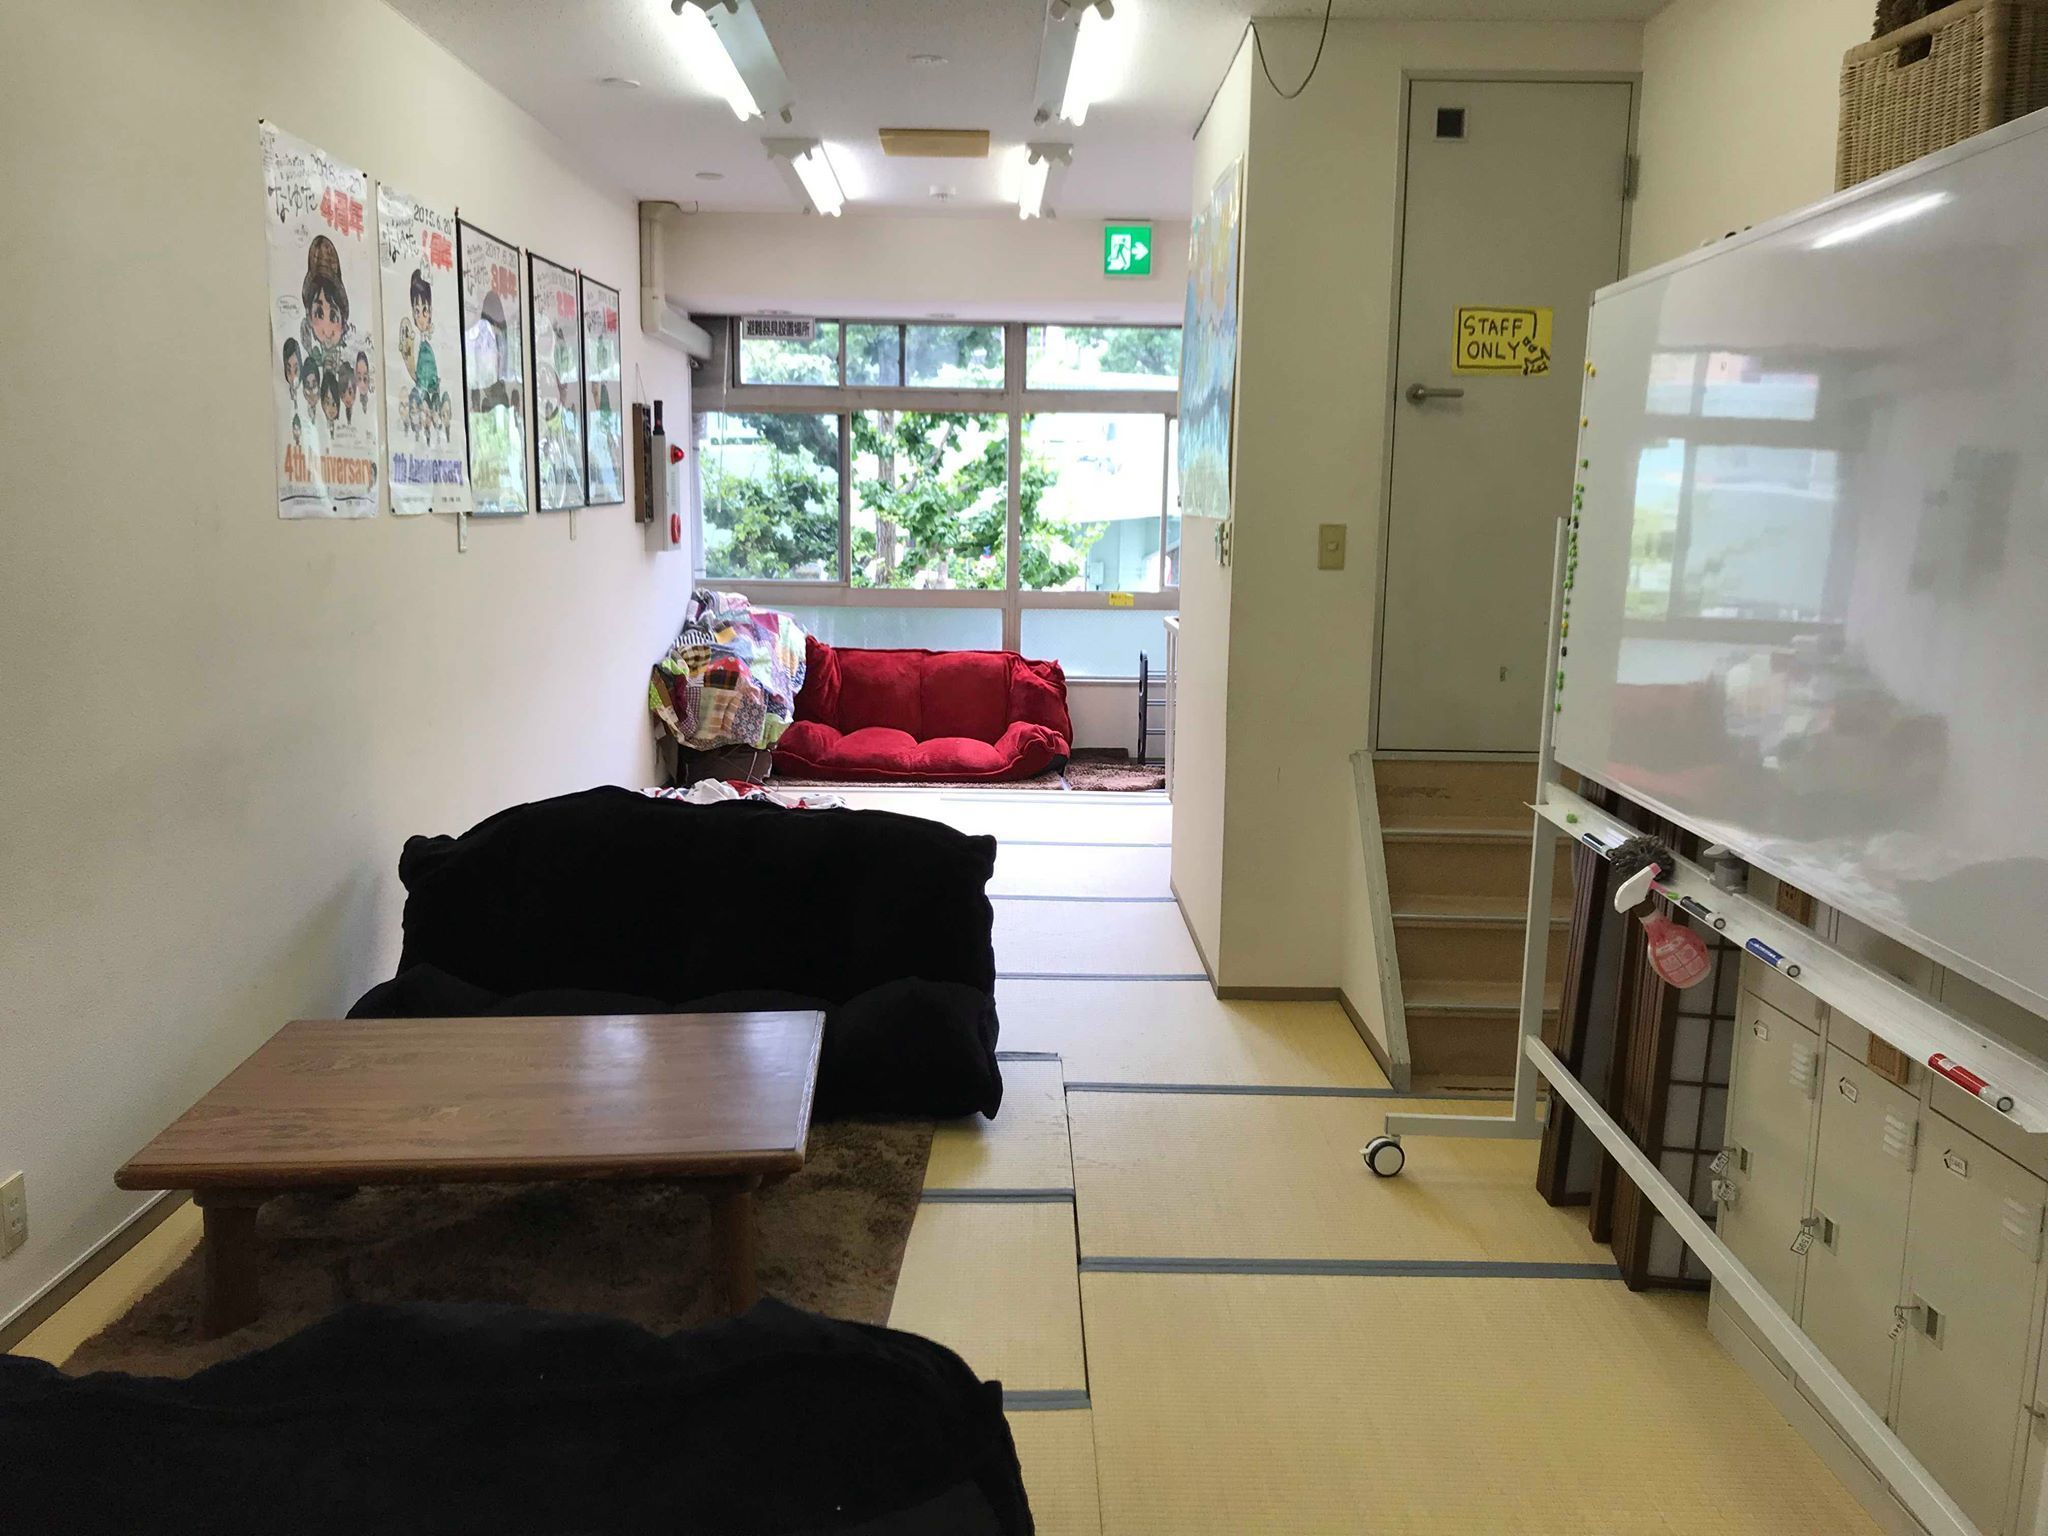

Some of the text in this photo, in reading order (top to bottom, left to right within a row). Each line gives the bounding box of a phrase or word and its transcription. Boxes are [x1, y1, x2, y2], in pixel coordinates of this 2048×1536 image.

[1463, 315, 1523, 338] STAFF
[1467, 341, 1520, 360] ONLY
[284, 443, 306, 482] 4th
